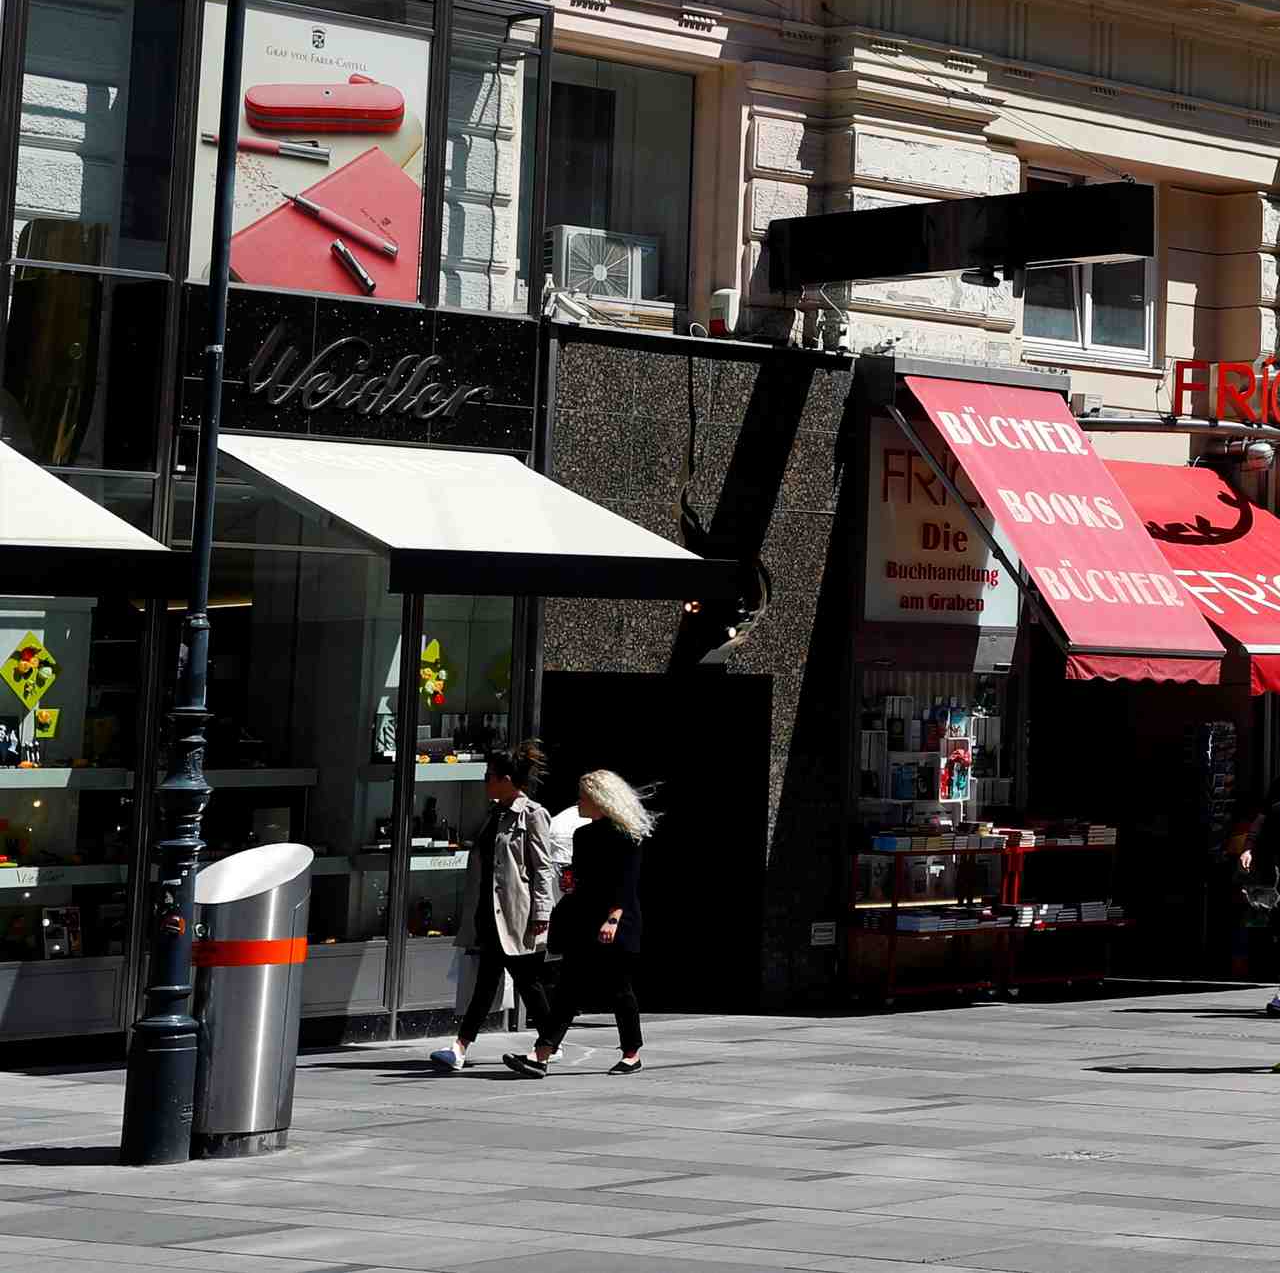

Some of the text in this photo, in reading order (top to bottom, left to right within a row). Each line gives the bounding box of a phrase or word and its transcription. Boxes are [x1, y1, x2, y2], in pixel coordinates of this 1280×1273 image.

[936, 406, 1089, 456] BÜCHER
[997, 487, 1124, 531] BOOKS
[921, 522, 968, 552] Die
[886, 561, 999, 587] Buchhandlung
[1034, 559, 1185, 607] BÜCHER
[900, 593, 985, 612] am Graben
